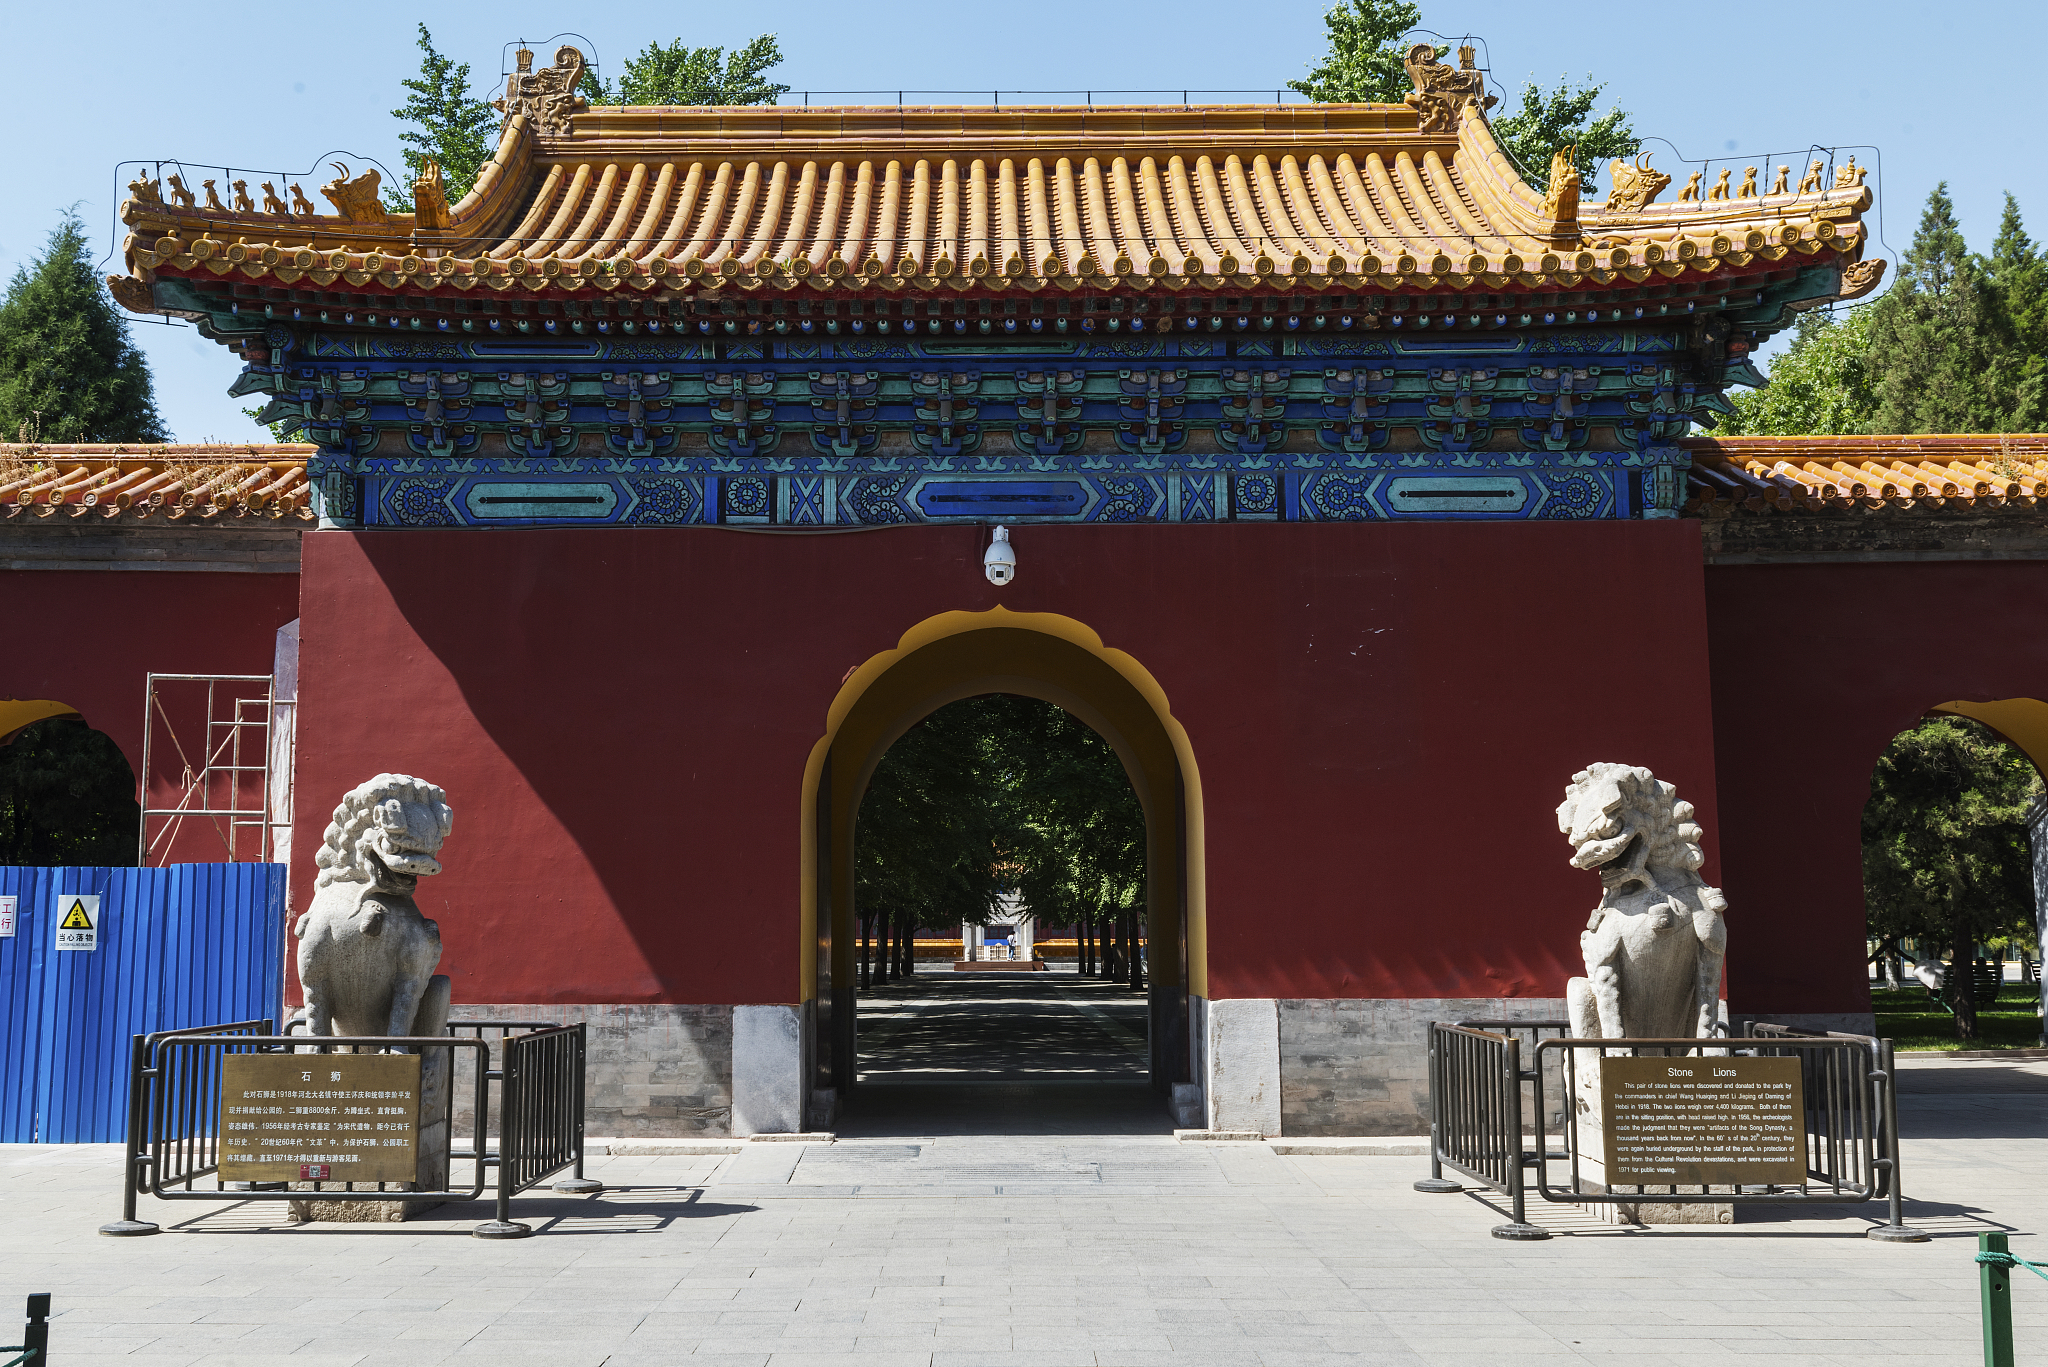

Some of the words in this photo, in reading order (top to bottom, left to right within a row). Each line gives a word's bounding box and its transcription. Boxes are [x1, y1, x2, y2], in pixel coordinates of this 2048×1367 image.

[59, 933, 93, 942] 当心落物
[1668, 1068, 1693, 1077] Stone
[1713, 1068, 1737, 1077] Lions
[1749, 1124, 1763, 1132] Song
